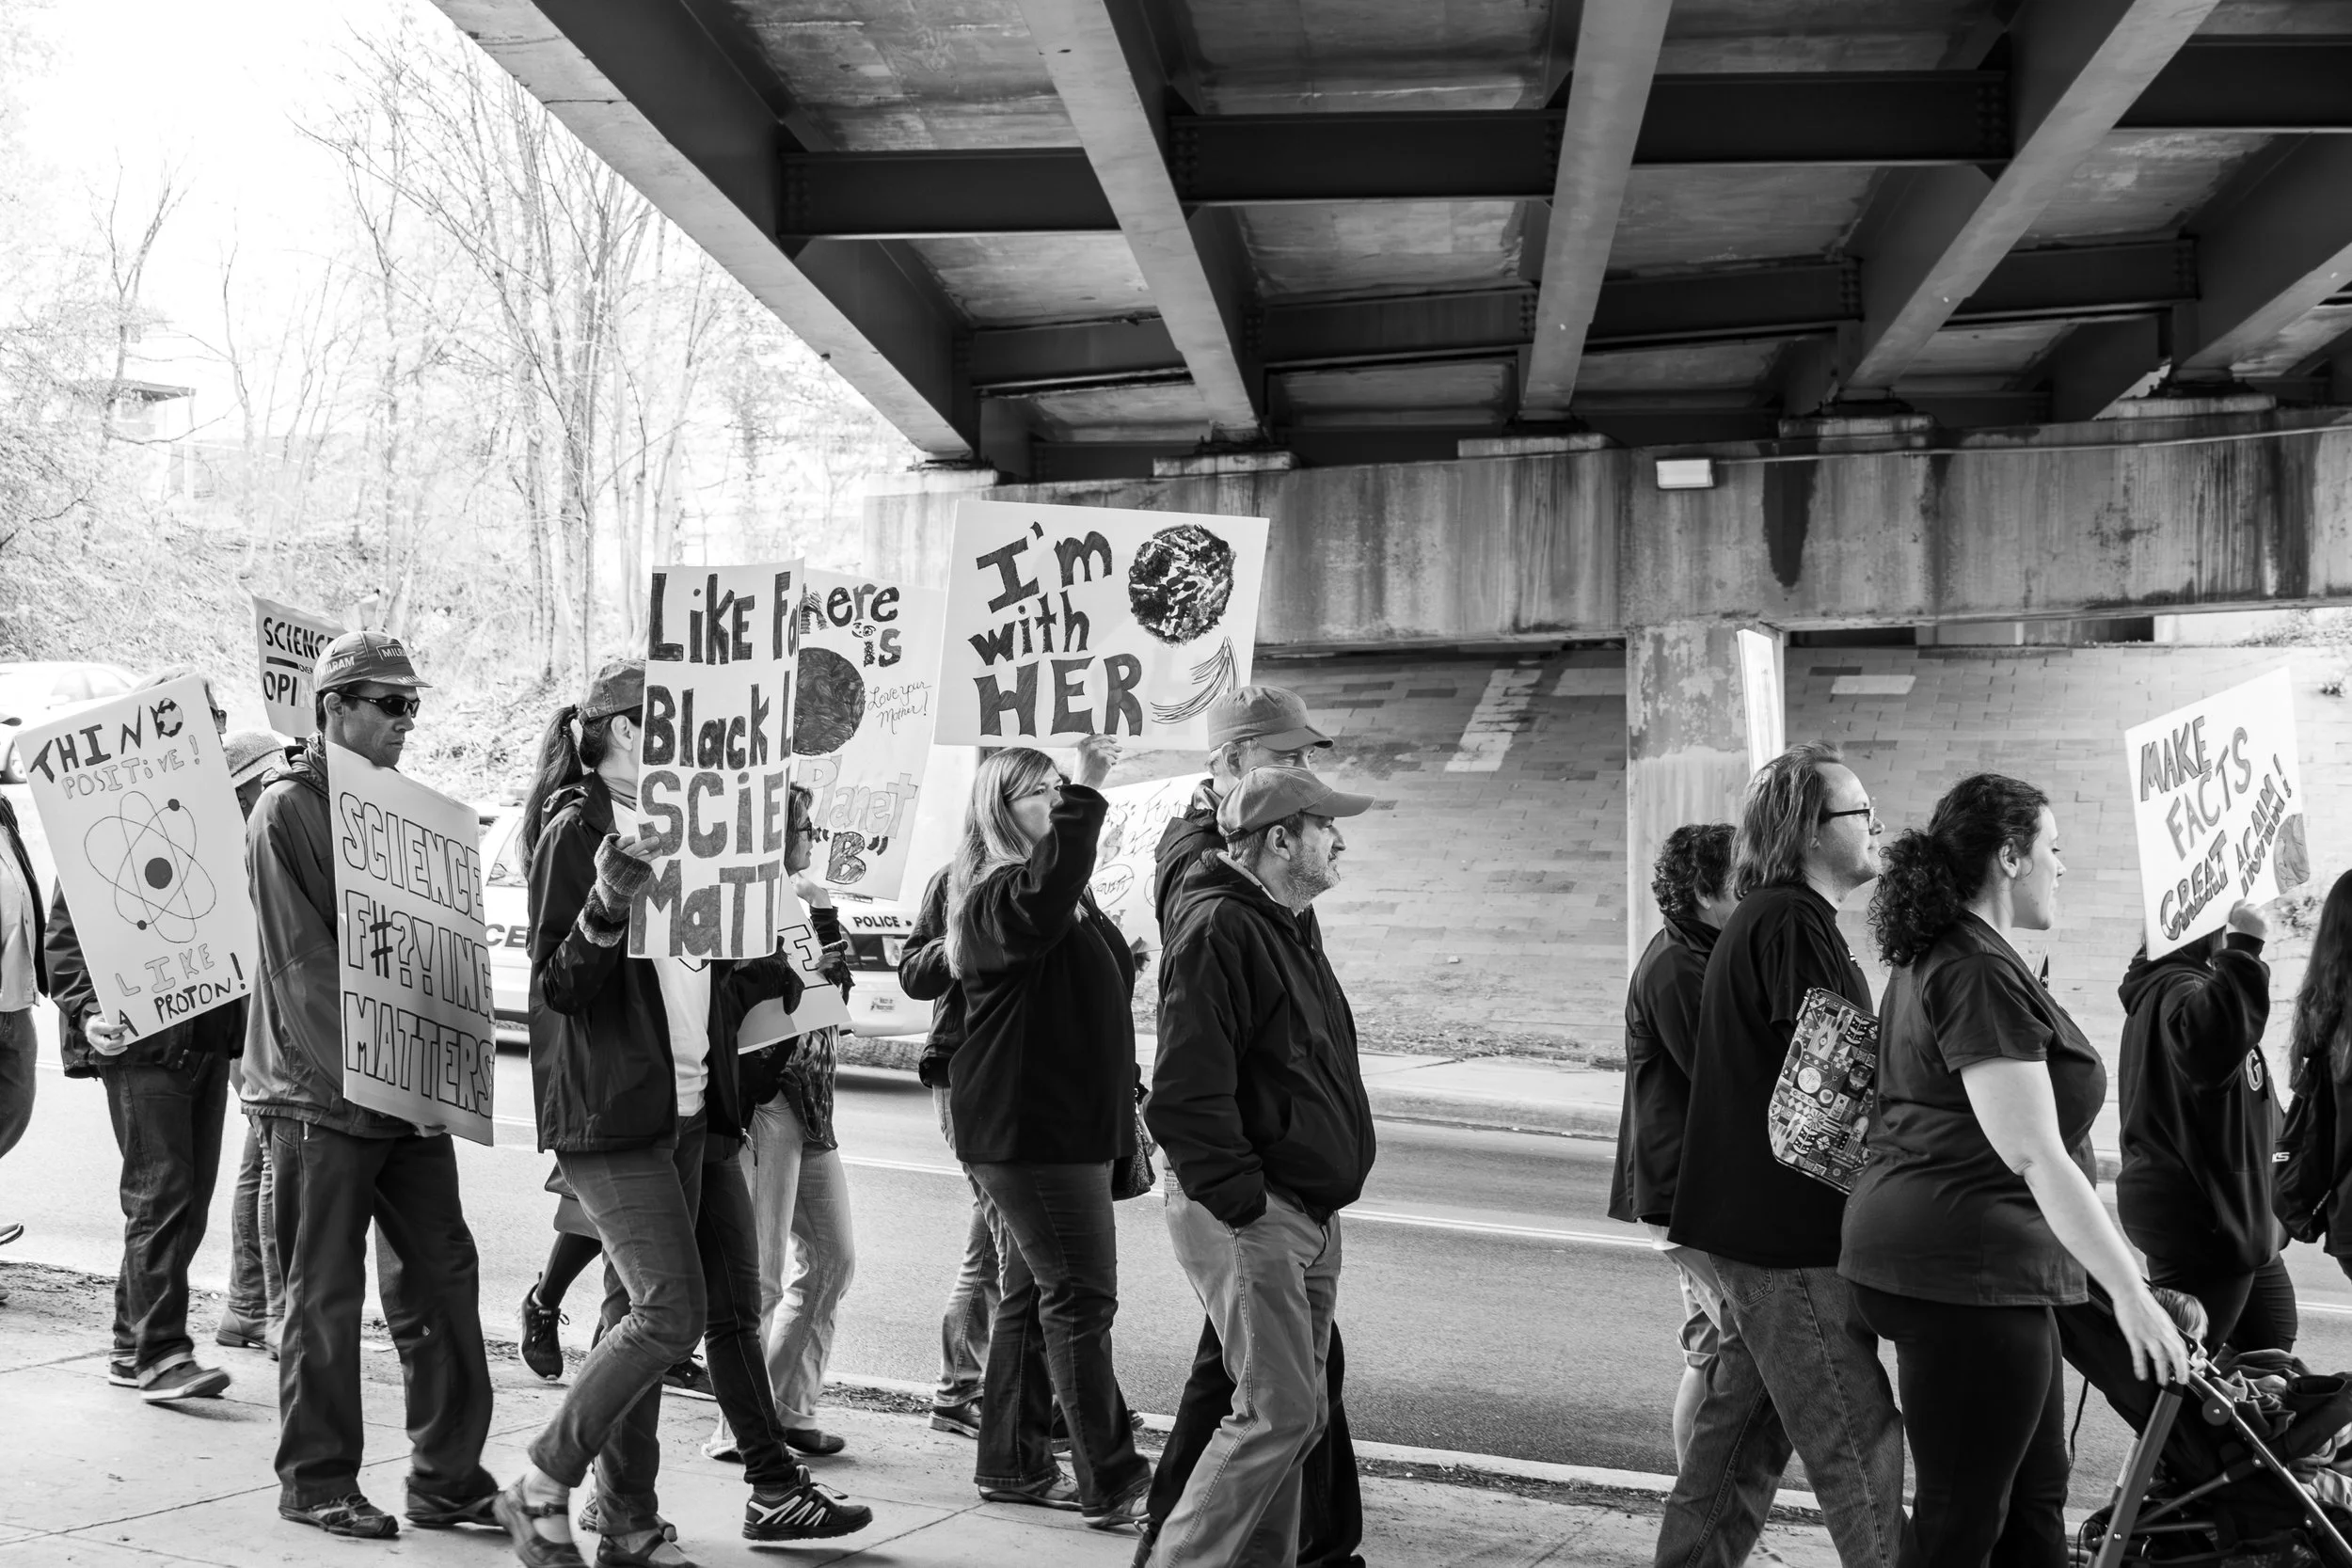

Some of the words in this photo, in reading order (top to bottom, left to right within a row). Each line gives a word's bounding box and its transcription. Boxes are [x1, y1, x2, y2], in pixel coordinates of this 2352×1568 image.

[977, 521, 1113, 613] I'm
[320, 656, 355, 676] MILRAM
[863, 625, 902, 668] is
[967, 591, 1090, 666] with
[643, 683, 770, 770] Black
[867, 686, 899, 711] Love
[898, 680, 932, 706] your
[876, 690, 929, 736] Mother!
[973, 653, 1143, 737] HER
[30, 698, 183, 784] THINK
[2140, 716, 2212, 801] MAKE
[797, 754, 919, 839] Planet
[2166, 726, 2251, 861] FACTS
[340, 792, 485, 926] SCIENCE
[2160, 830, 2229, 941] GREAT
[852, 915, 901, 928] POLICE
[115, 942, 215, 997] LIKE
[119, 1009, 139, 1037] A
[153, 952, 246, 1024] PROTON!
[343, 990, 496, 1119] MATTERS
